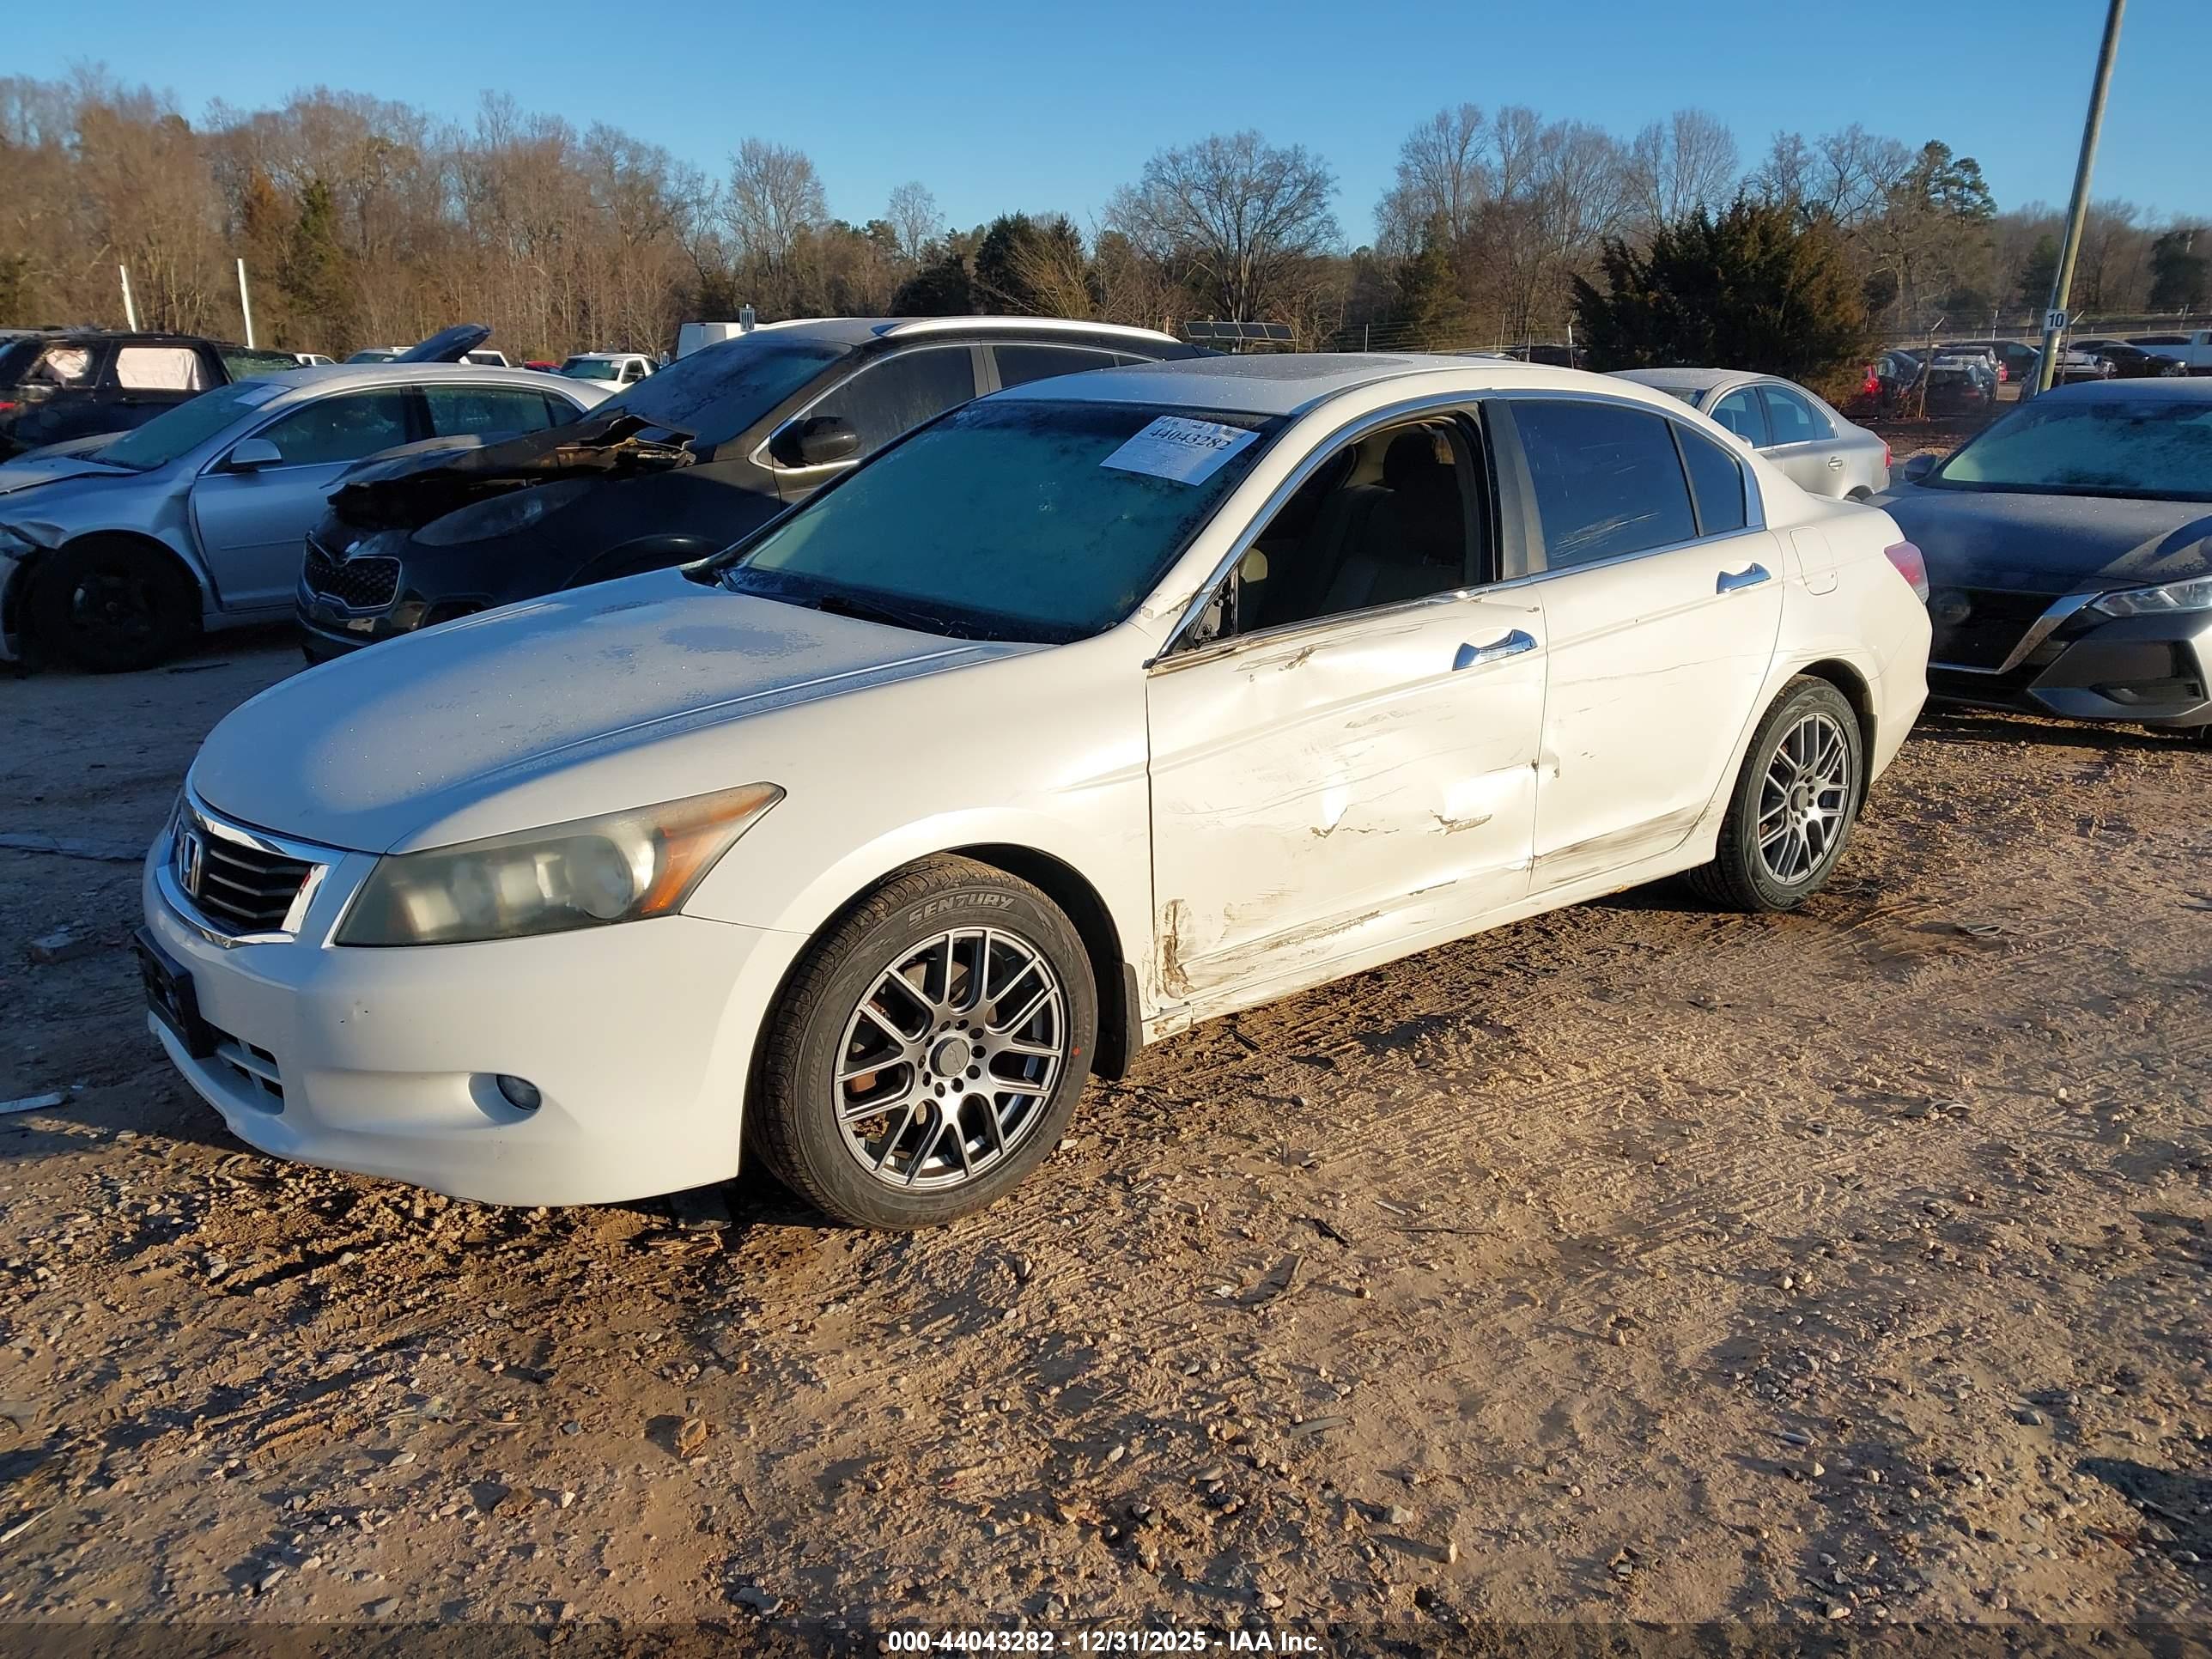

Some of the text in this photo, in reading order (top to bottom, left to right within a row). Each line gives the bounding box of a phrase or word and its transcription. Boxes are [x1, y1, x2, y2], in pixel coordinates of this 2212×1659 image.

[2048, 313, 2065, 328] 10
[1148, 428, 1231, 451] 44043282
[908, 892, 1016, 928] SENTURY
